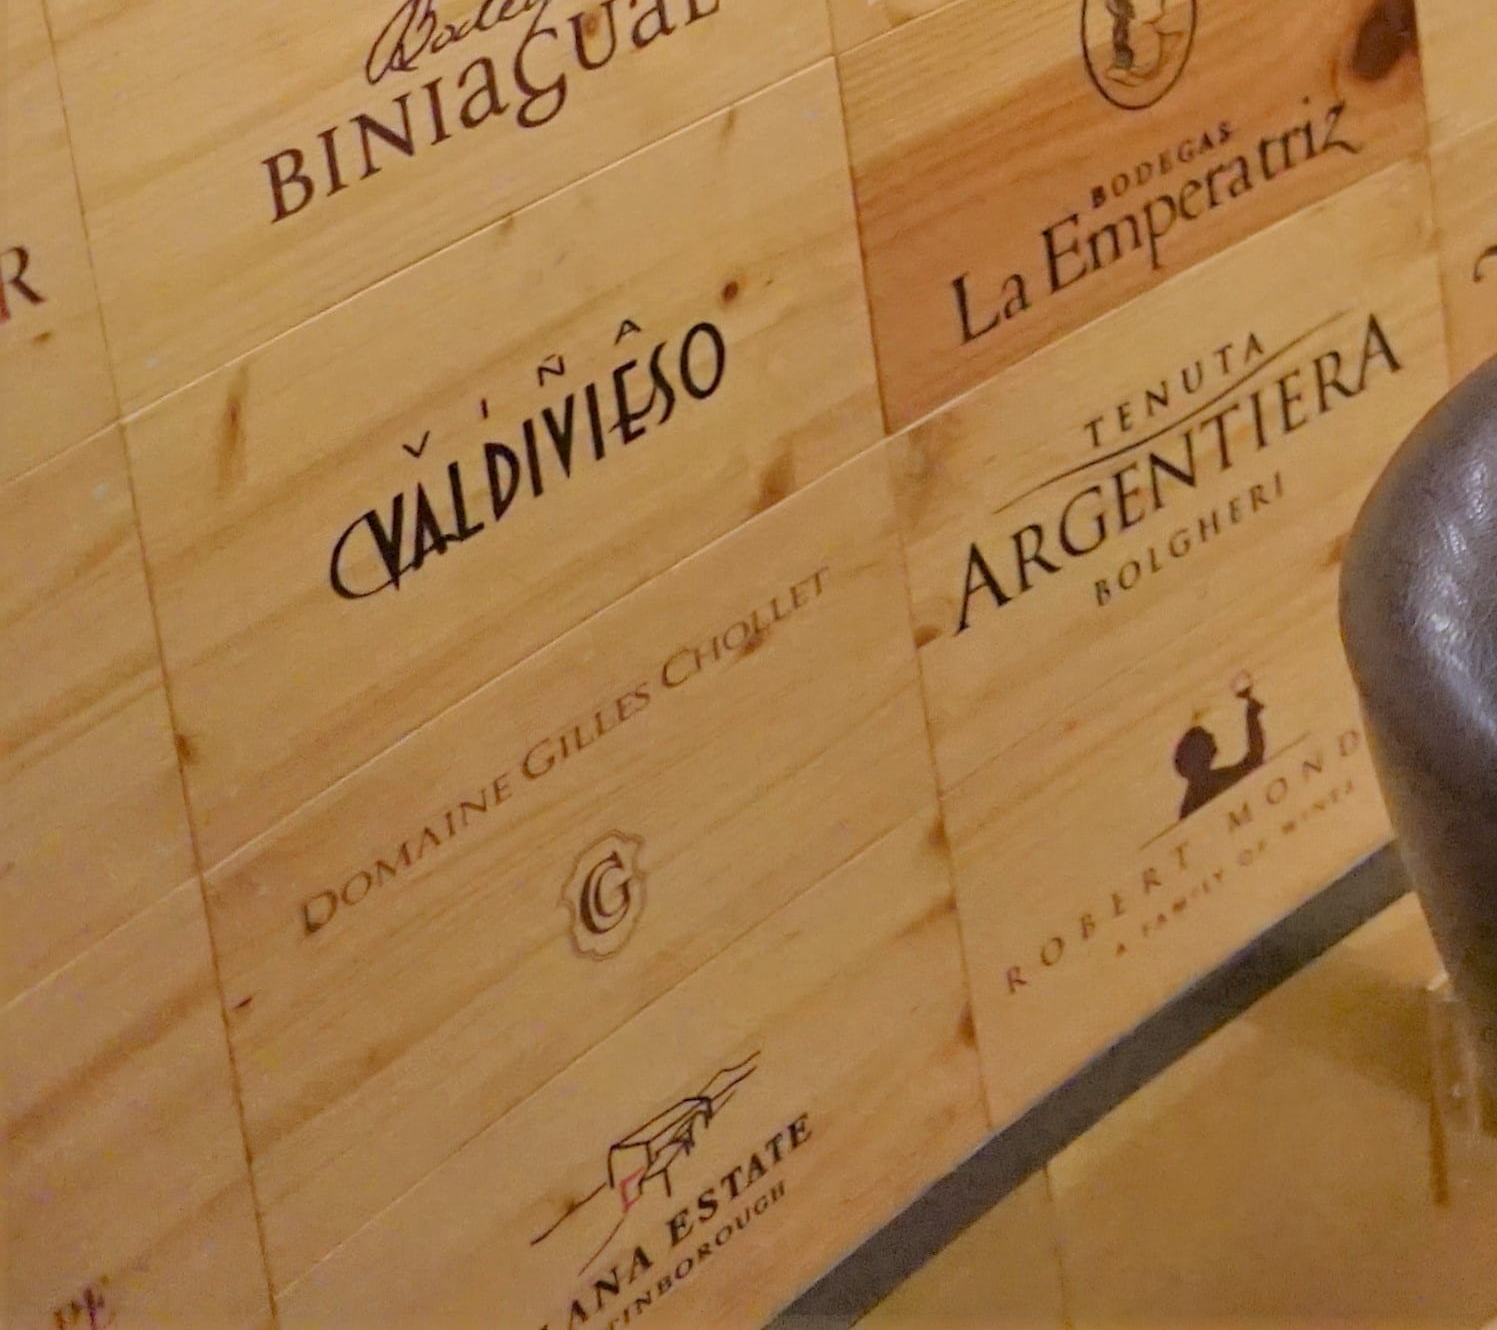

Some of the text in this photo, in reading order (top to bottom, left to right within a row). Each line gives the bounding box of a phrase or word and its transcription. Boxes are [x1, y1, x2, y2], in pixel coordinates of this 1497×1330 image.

[949, 96, 1364, 345] La Emperatriz
[1089, 120, 1236, 212] BODEGAS
[328, 320, 727, 602] VALDIVIESO
[954, 310, 1404, 638] ARGENTIERA
[1083, 330, 1266, 450] TENUTA
[1093, 473, 1286, 608] BOLGHERI
[301, 565, 831, 937] DOMAINE GILLES CHOLLET
[1005, 728, 1361, 995] ROBERT MOND
[664, 1111, 814, 1248] ESTATE
